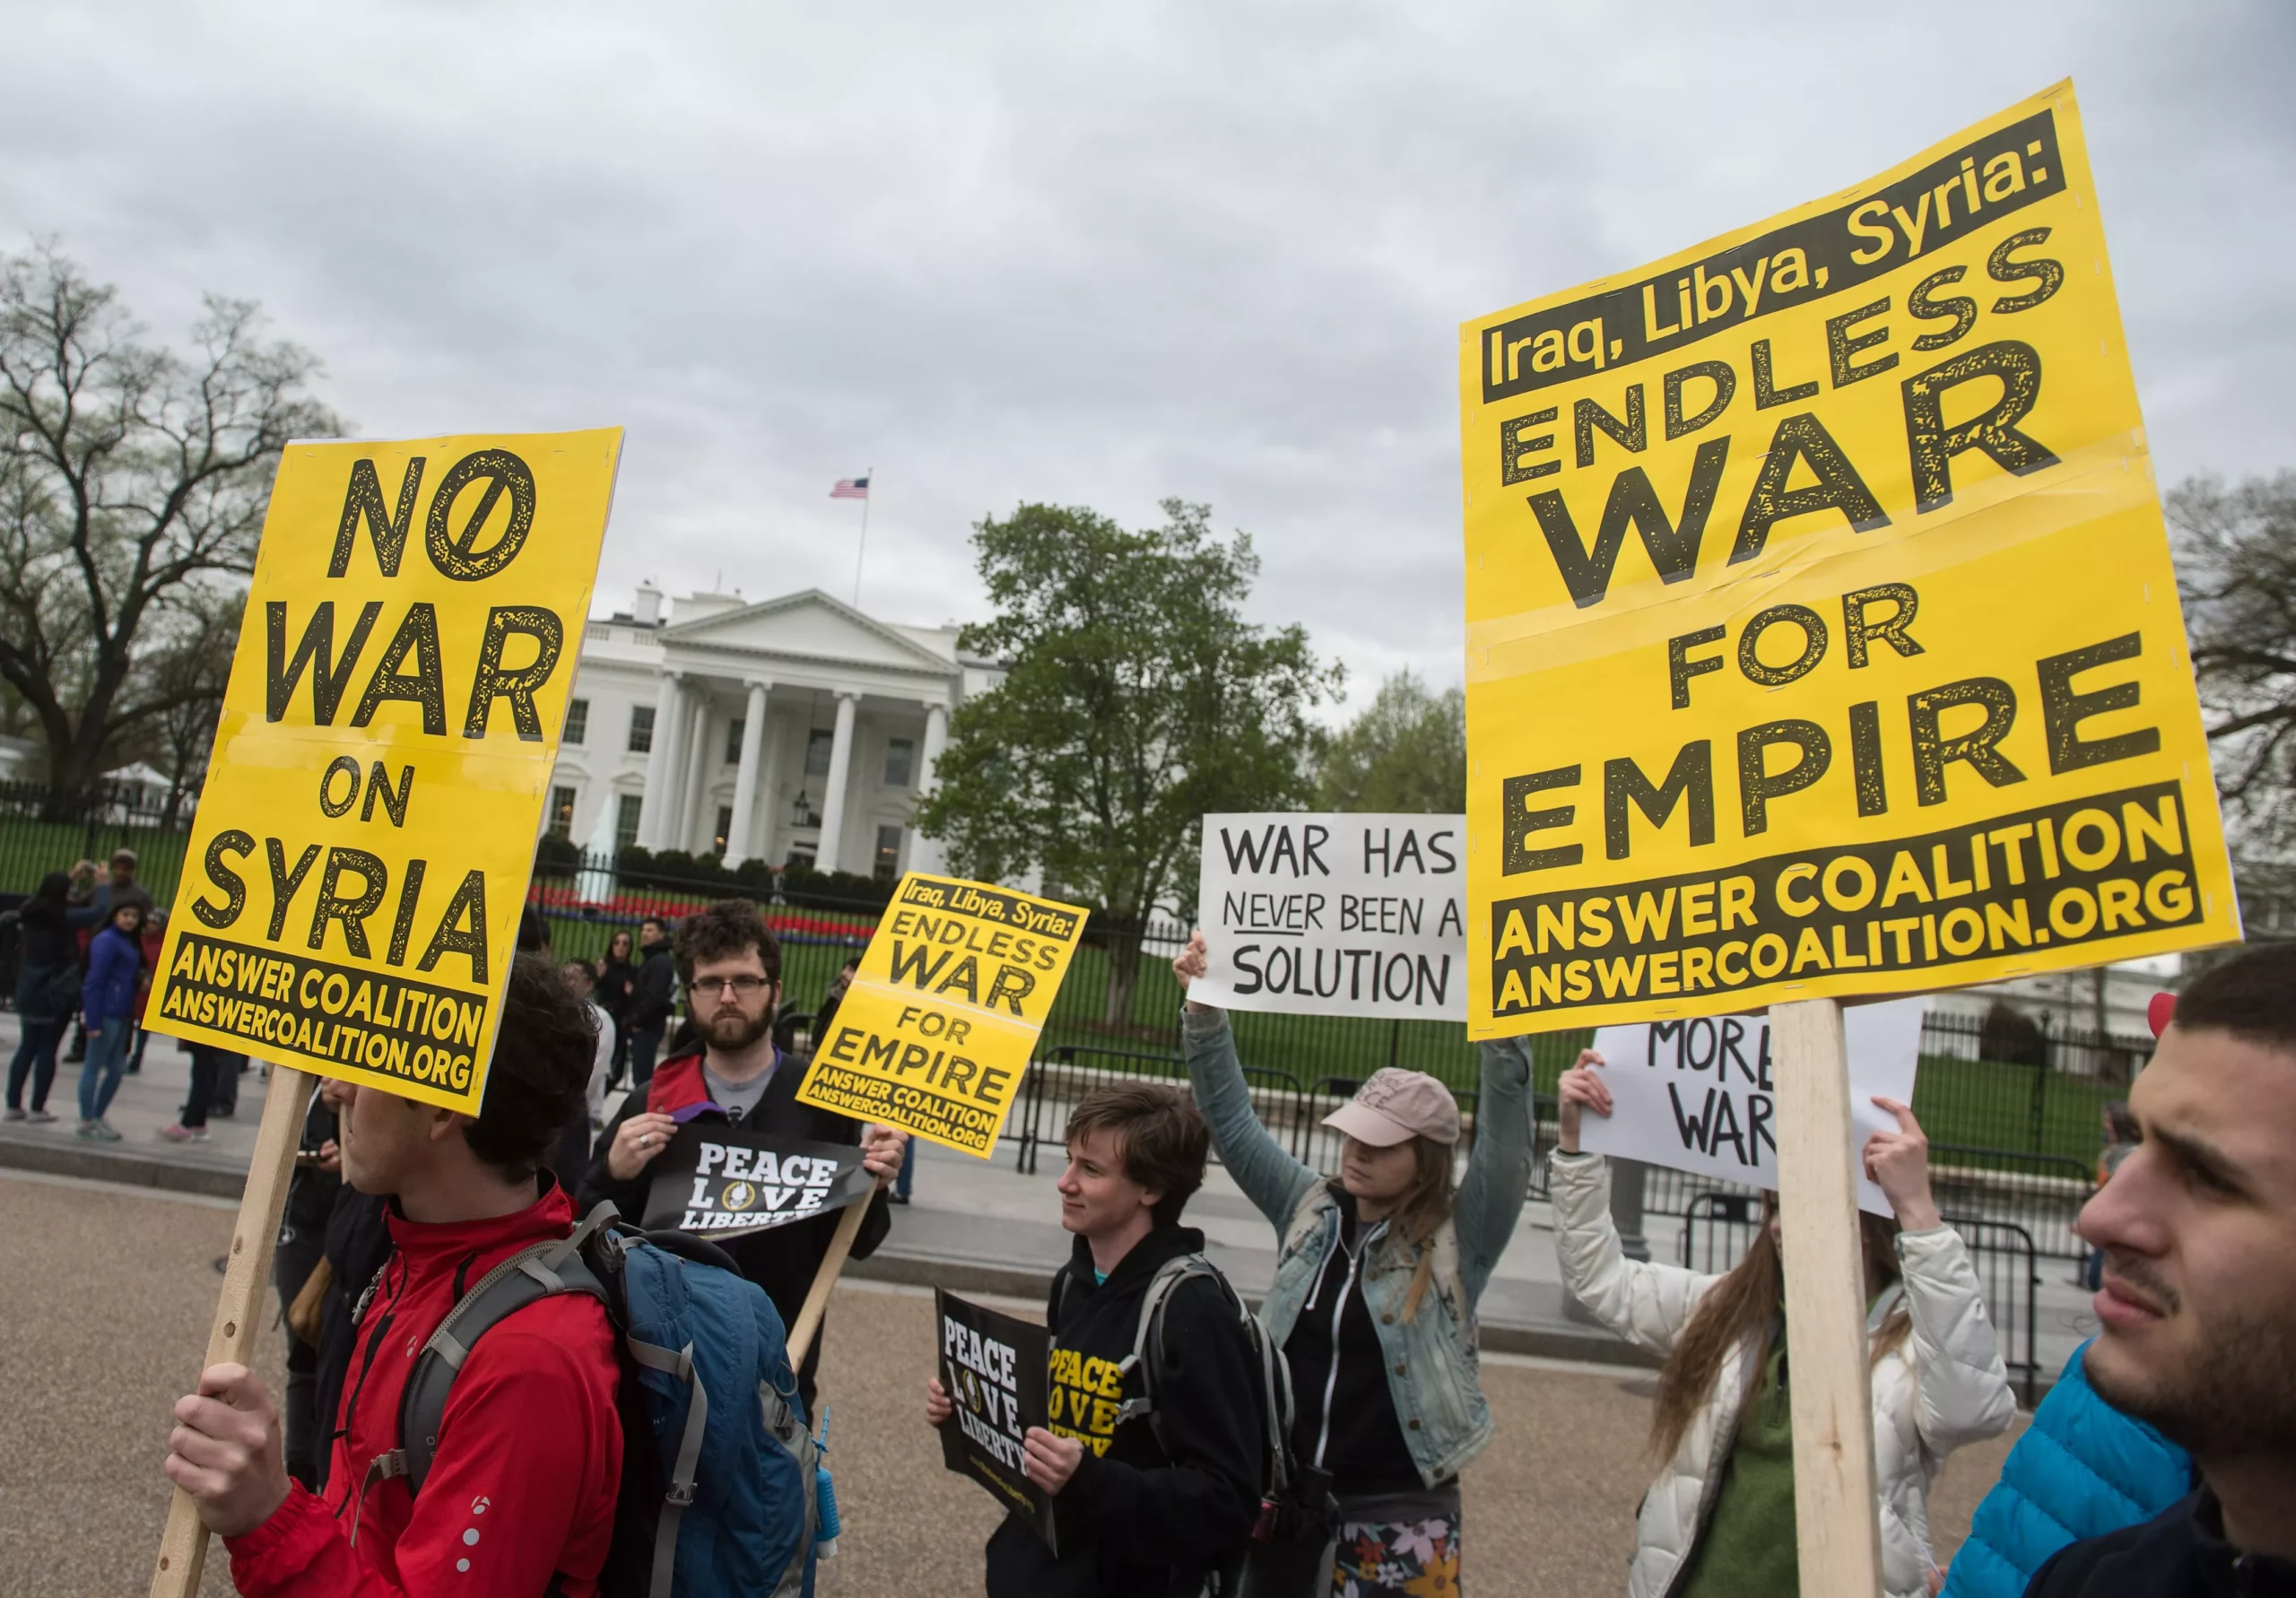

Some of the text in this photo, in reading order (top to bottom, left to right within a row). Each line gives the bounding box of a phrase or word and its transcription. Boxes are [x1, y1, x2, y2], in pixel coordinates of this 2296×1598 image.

[1490, 139, 2048, 386] Iraq, Libya, Syria:
[1501, 226, 2065, 487] ENDLESS
[327, 448, 535, 581] NO
[1526, 340, 2062, 610] WAR
[265, 601, 564, 742] WAR
[1669, 582, 1926, 710] FOR
[320, 756, 414, 828] ON
[1501, 630, 2162, 877] EMPIRE
[1220, 824, 1457, 878] WAR HAS
[1495, 795, 2184, 960] ANSWER COALITION
[191, 829, 488, 985] SYRIA
[890, 910, 1060, 971] ENDLESS
[904, 879, 1074, 937] Iraq, Libya, Syria:
[1223, 890, 1463, 937] NEVER BEEN A
[1497, 870, 2193, 1011] ANSWERCOALITION.ORG
[172, 950, 482, 1046] ANSWER COALITION
[889, 940, 1036, 1017] WAR
[1232, 944, 1450, 1005] SOLUTION
[163, 986, 472, 1083] ANSWERCOALITION.ORG
[897, 1006, 971, 1045] FOR
[814, 1066, 996, 1133] ANSWER COALITION
[829, 1027, 1012, 1107] EMPIRE
[808, 1083, 987, 1150] ANSWERCOALITION.ORG
[1667, 1081, 1777, 1167] WAR
[696, 1142, 838, 1187] PEACE
[944, 1315, 1016, 1393] PEACE
[1049, 1349, 1124, 1400] PEACE
[1049, 1385, 1119, 1435] OVE
